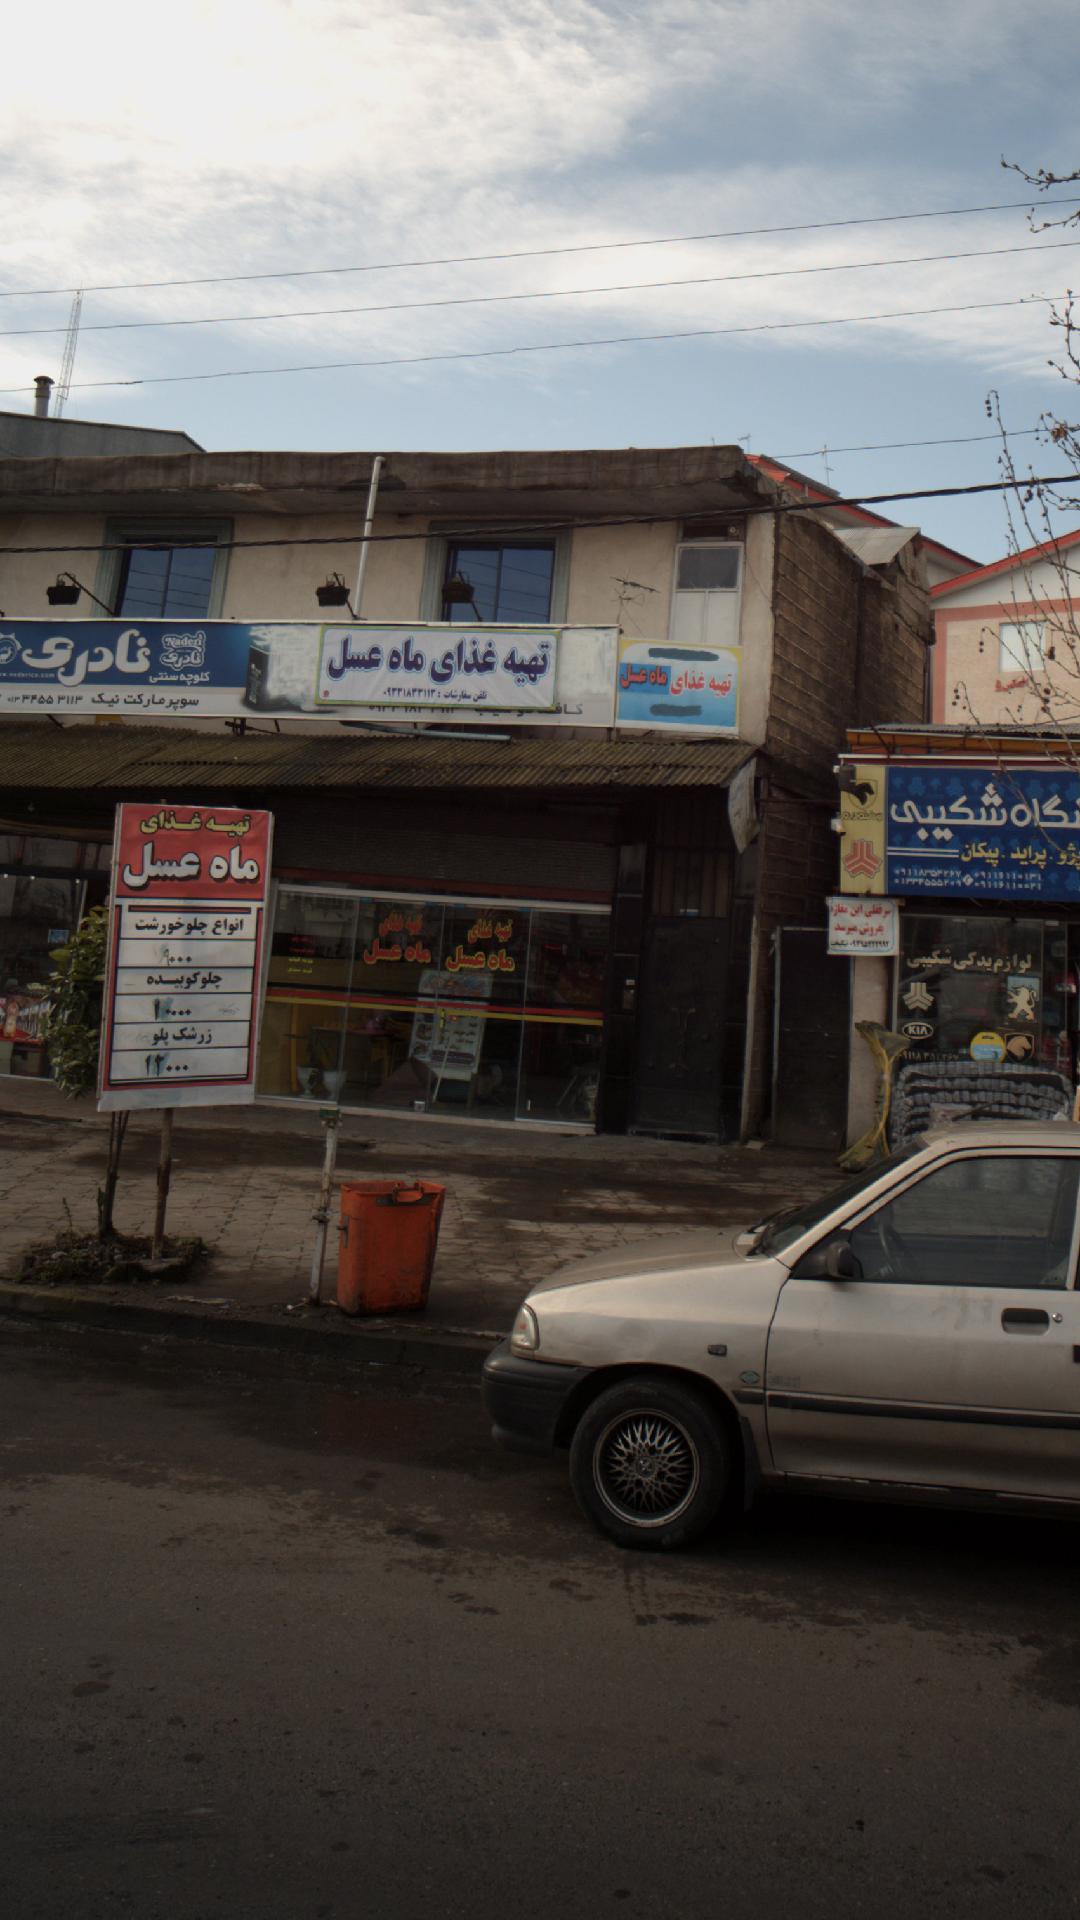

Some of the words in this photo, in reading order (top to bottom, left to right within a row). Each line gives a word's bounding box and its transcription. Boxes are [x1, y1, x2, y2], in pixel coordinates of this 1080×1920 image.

[165, 632, 204, 648] Naderi
[22, 629, 151, 687] نادری
[326, 633, 382, 681] عسل
[388, 636, 427, 673] ماه
[430, 637, 498, 684] غذای
[503, 641, 552, 687] تهیه
[149, 672, 179, 684] سنتی
[180, 672, 210, 685] کلوچه
[619, 662, 647, 688] عسل
[649, 665, 668, 686] ماه
[670, 670, 705, 695] غذای
[708, 674, 733, 697] تهیه
[92, 693, 121, 707] نیک
[473, 691, 488, 702] تلفن
[140, 809, 202, 834] غذای
[890, 782, 1007, 842] شکیبی
[205, 813, 251, 837] تهیه
[123, 842, 202, 890] عسل
[208, 844, 260, 882] ماه
[960, 842, 1000, 866] پیکان
[1010, 841, 1047, 869] پراید
[212, 918, 244, 935] انواع
[363, 936, 403, 965] عسل
[404, 939, 432, 964] ماه
[446, 944, 486, 972] عسل
[487, 948, 516, 972] ماه
[906, 947, 953, 969] شکیبی
[151, 1027, 169, 1046] پلو
[172, 1026, 213, 1044] زرشک
[908, 1024, 929, 1036] KIA
